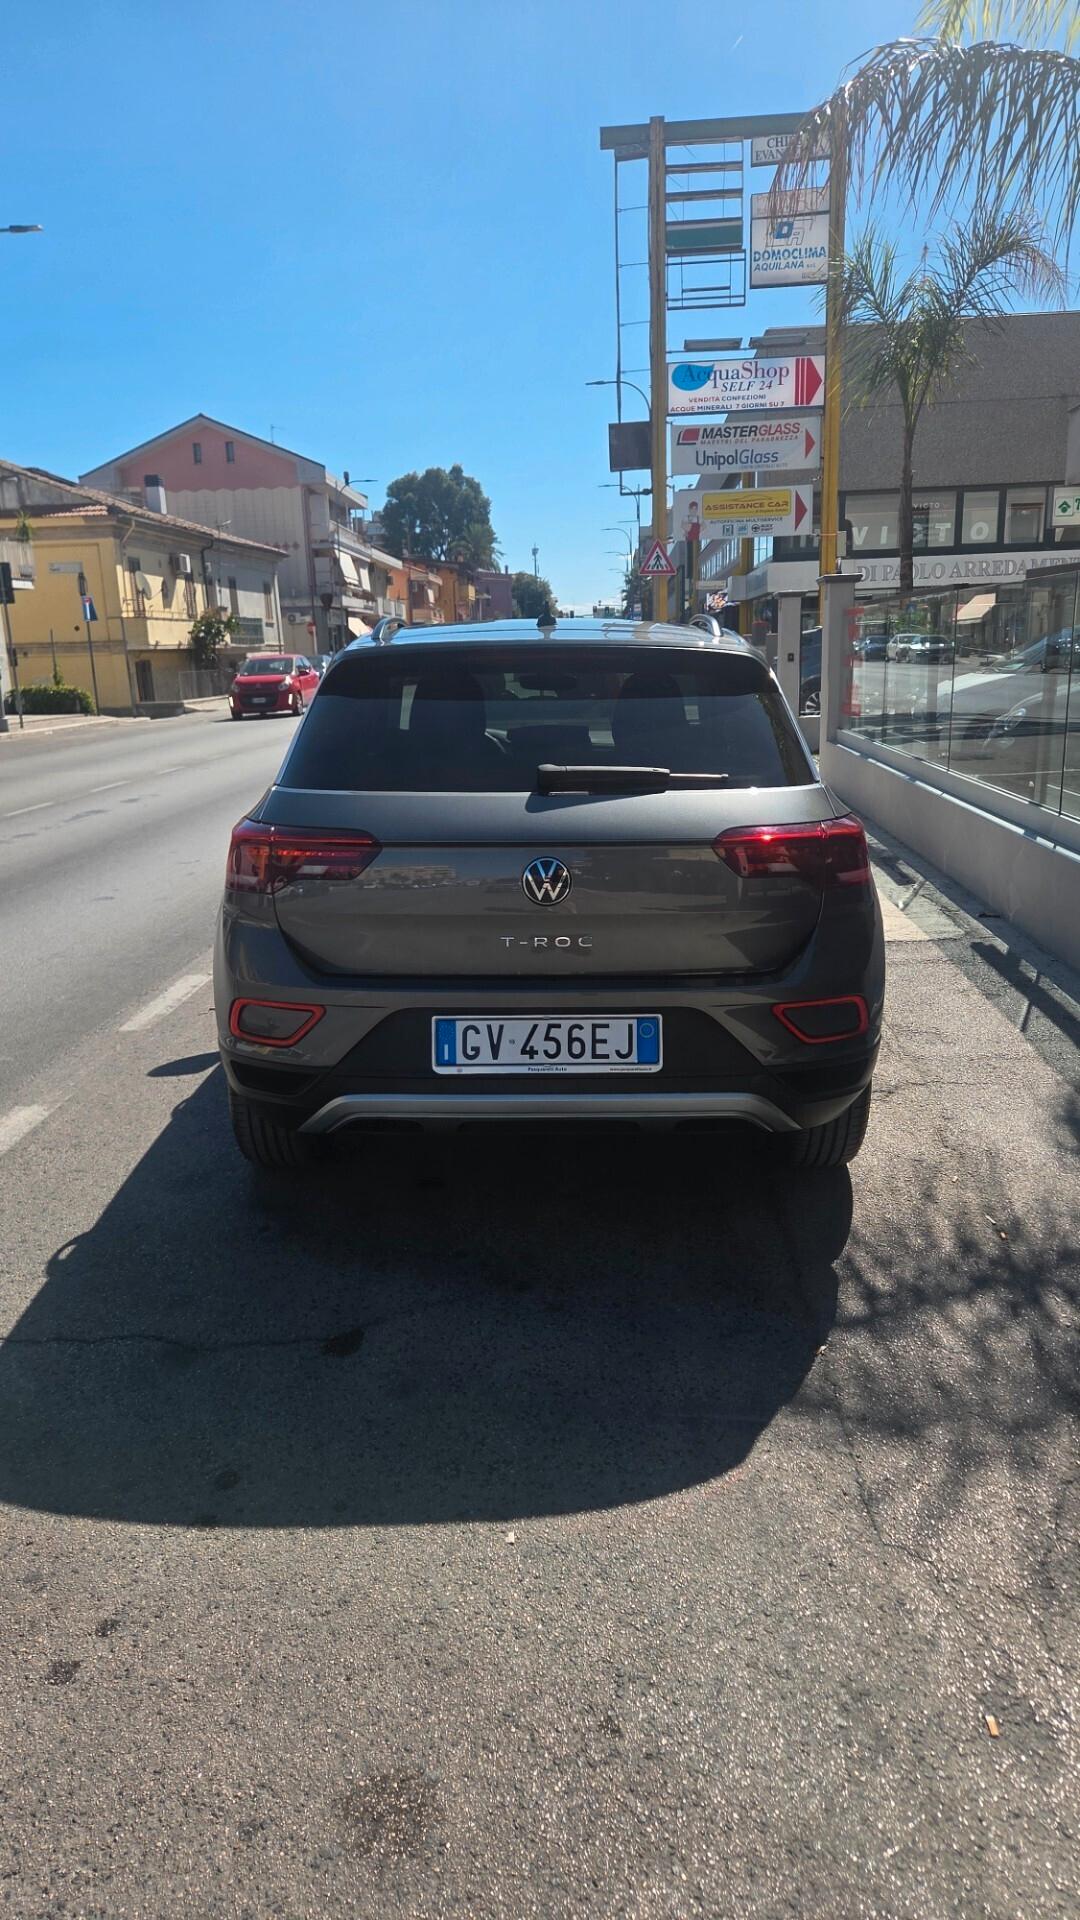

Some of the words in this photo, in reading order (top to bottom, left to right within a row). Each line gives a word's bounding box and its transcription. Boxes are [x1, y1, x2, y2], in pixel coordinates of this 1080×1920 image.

[753, 246, 826, 262] DOMOCLIMA
[753, 260, 804, 272] AQUILANA
[681, 361, 790, 389] AcquaShop
[721, 381, 756, 392] SELF
[759, 380, 774, 391] 24
[721, 394, 766, 402] CONFEZIONI
[702, 422, 801, 440] MASTERGLASS
[695, 449, 779, 471] UnipolGlass
[705, 501, 765, 511] ASSISTANCE
[767, 500, 789, 508] CAR
[857, 565, 879, 581] DI
[500, 936, 593, 947] T-ROC
[461, 1023, 504, 1061] GV
[520, 1023, 634, 1061] 456EJ
